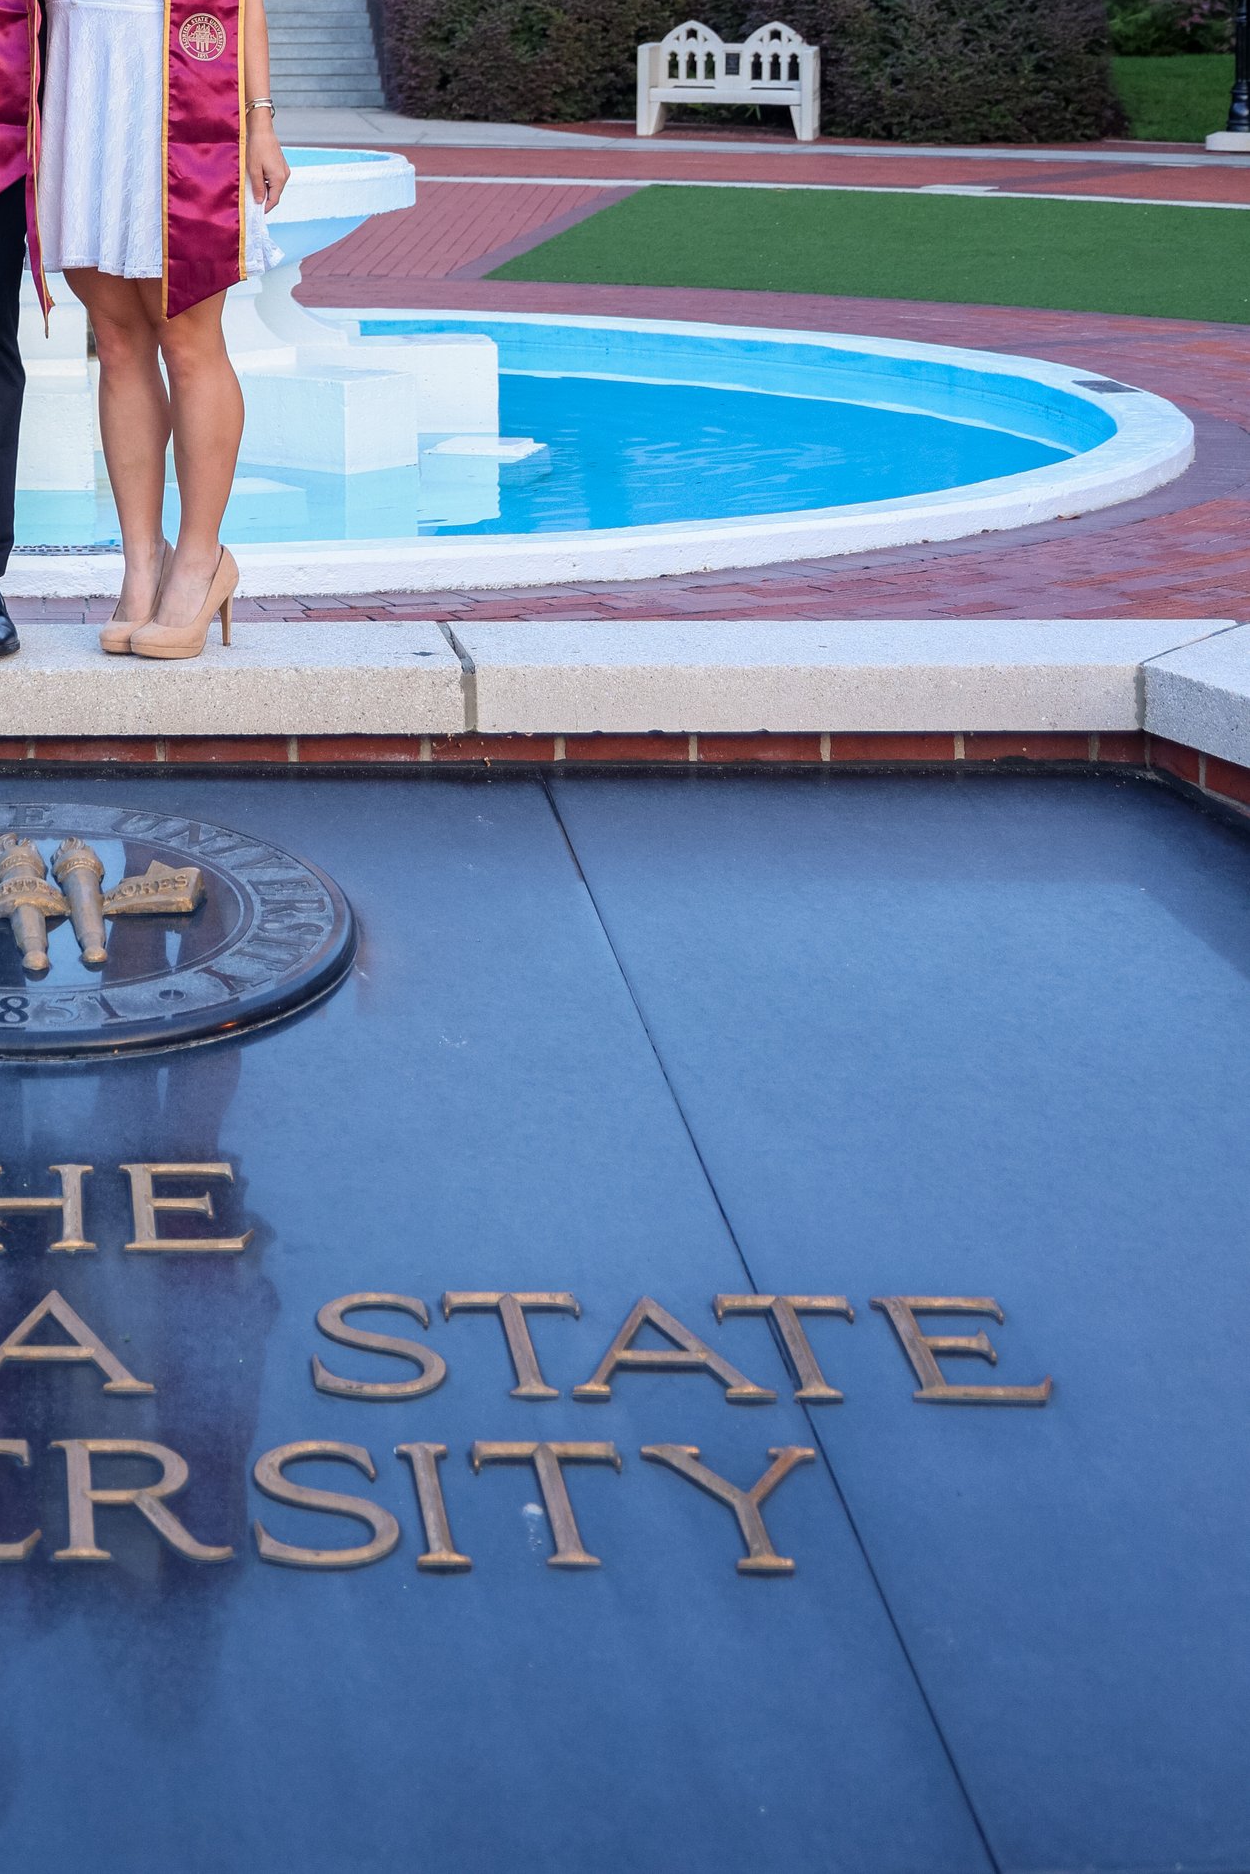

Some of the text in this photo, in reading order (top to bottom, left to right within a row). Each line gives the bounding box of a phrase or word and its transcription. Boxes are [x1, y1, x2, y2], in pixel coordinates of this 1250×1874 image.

[191, 16, 209, 25] STATE
[112, 811, 327, 996] UNIVERSITY
[311, 1290, 1053, 1406] STATE
